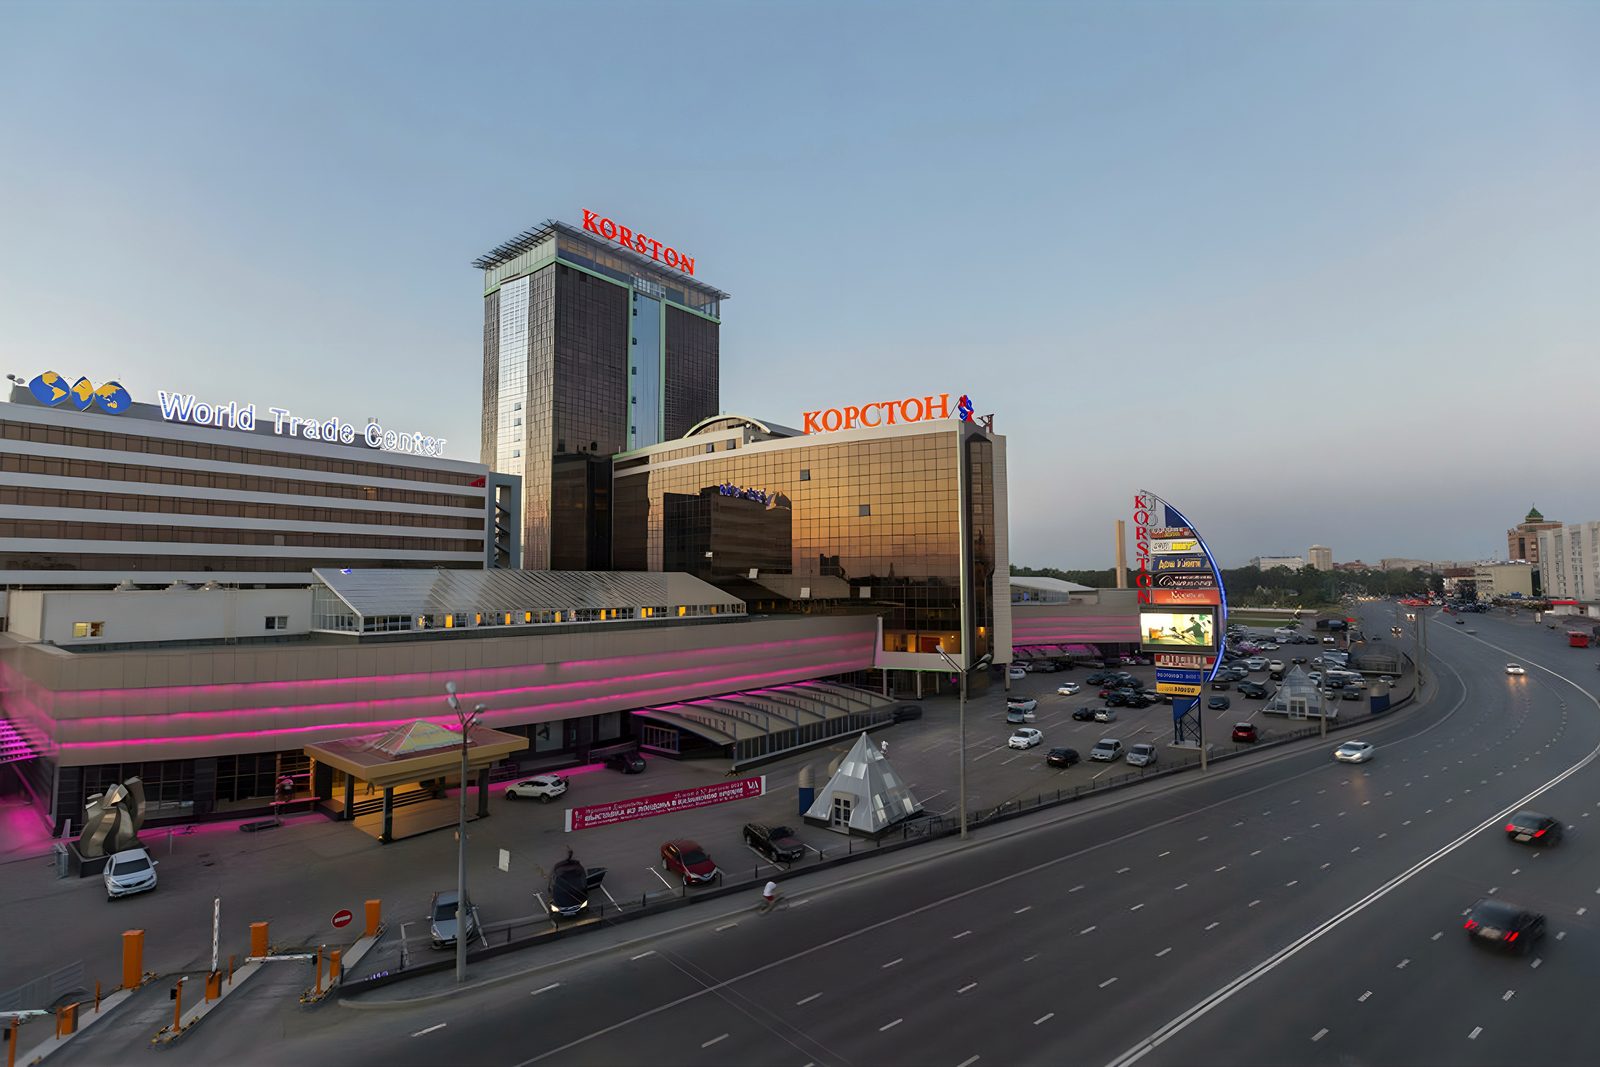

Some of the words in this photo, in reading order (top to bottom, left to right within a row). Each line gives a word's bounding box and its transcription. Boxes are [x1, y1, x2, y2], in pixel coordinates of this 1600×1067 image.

[582, 208, 695, 276] KORSTON
[158, 390, 256, 431] World
[269, 407, 355, 444] Trade
[364, 422, 447, 456] Center
[802, 393, 950, 435] КОРСТОН
[1133, 495, 1152, 604] KORSTON
